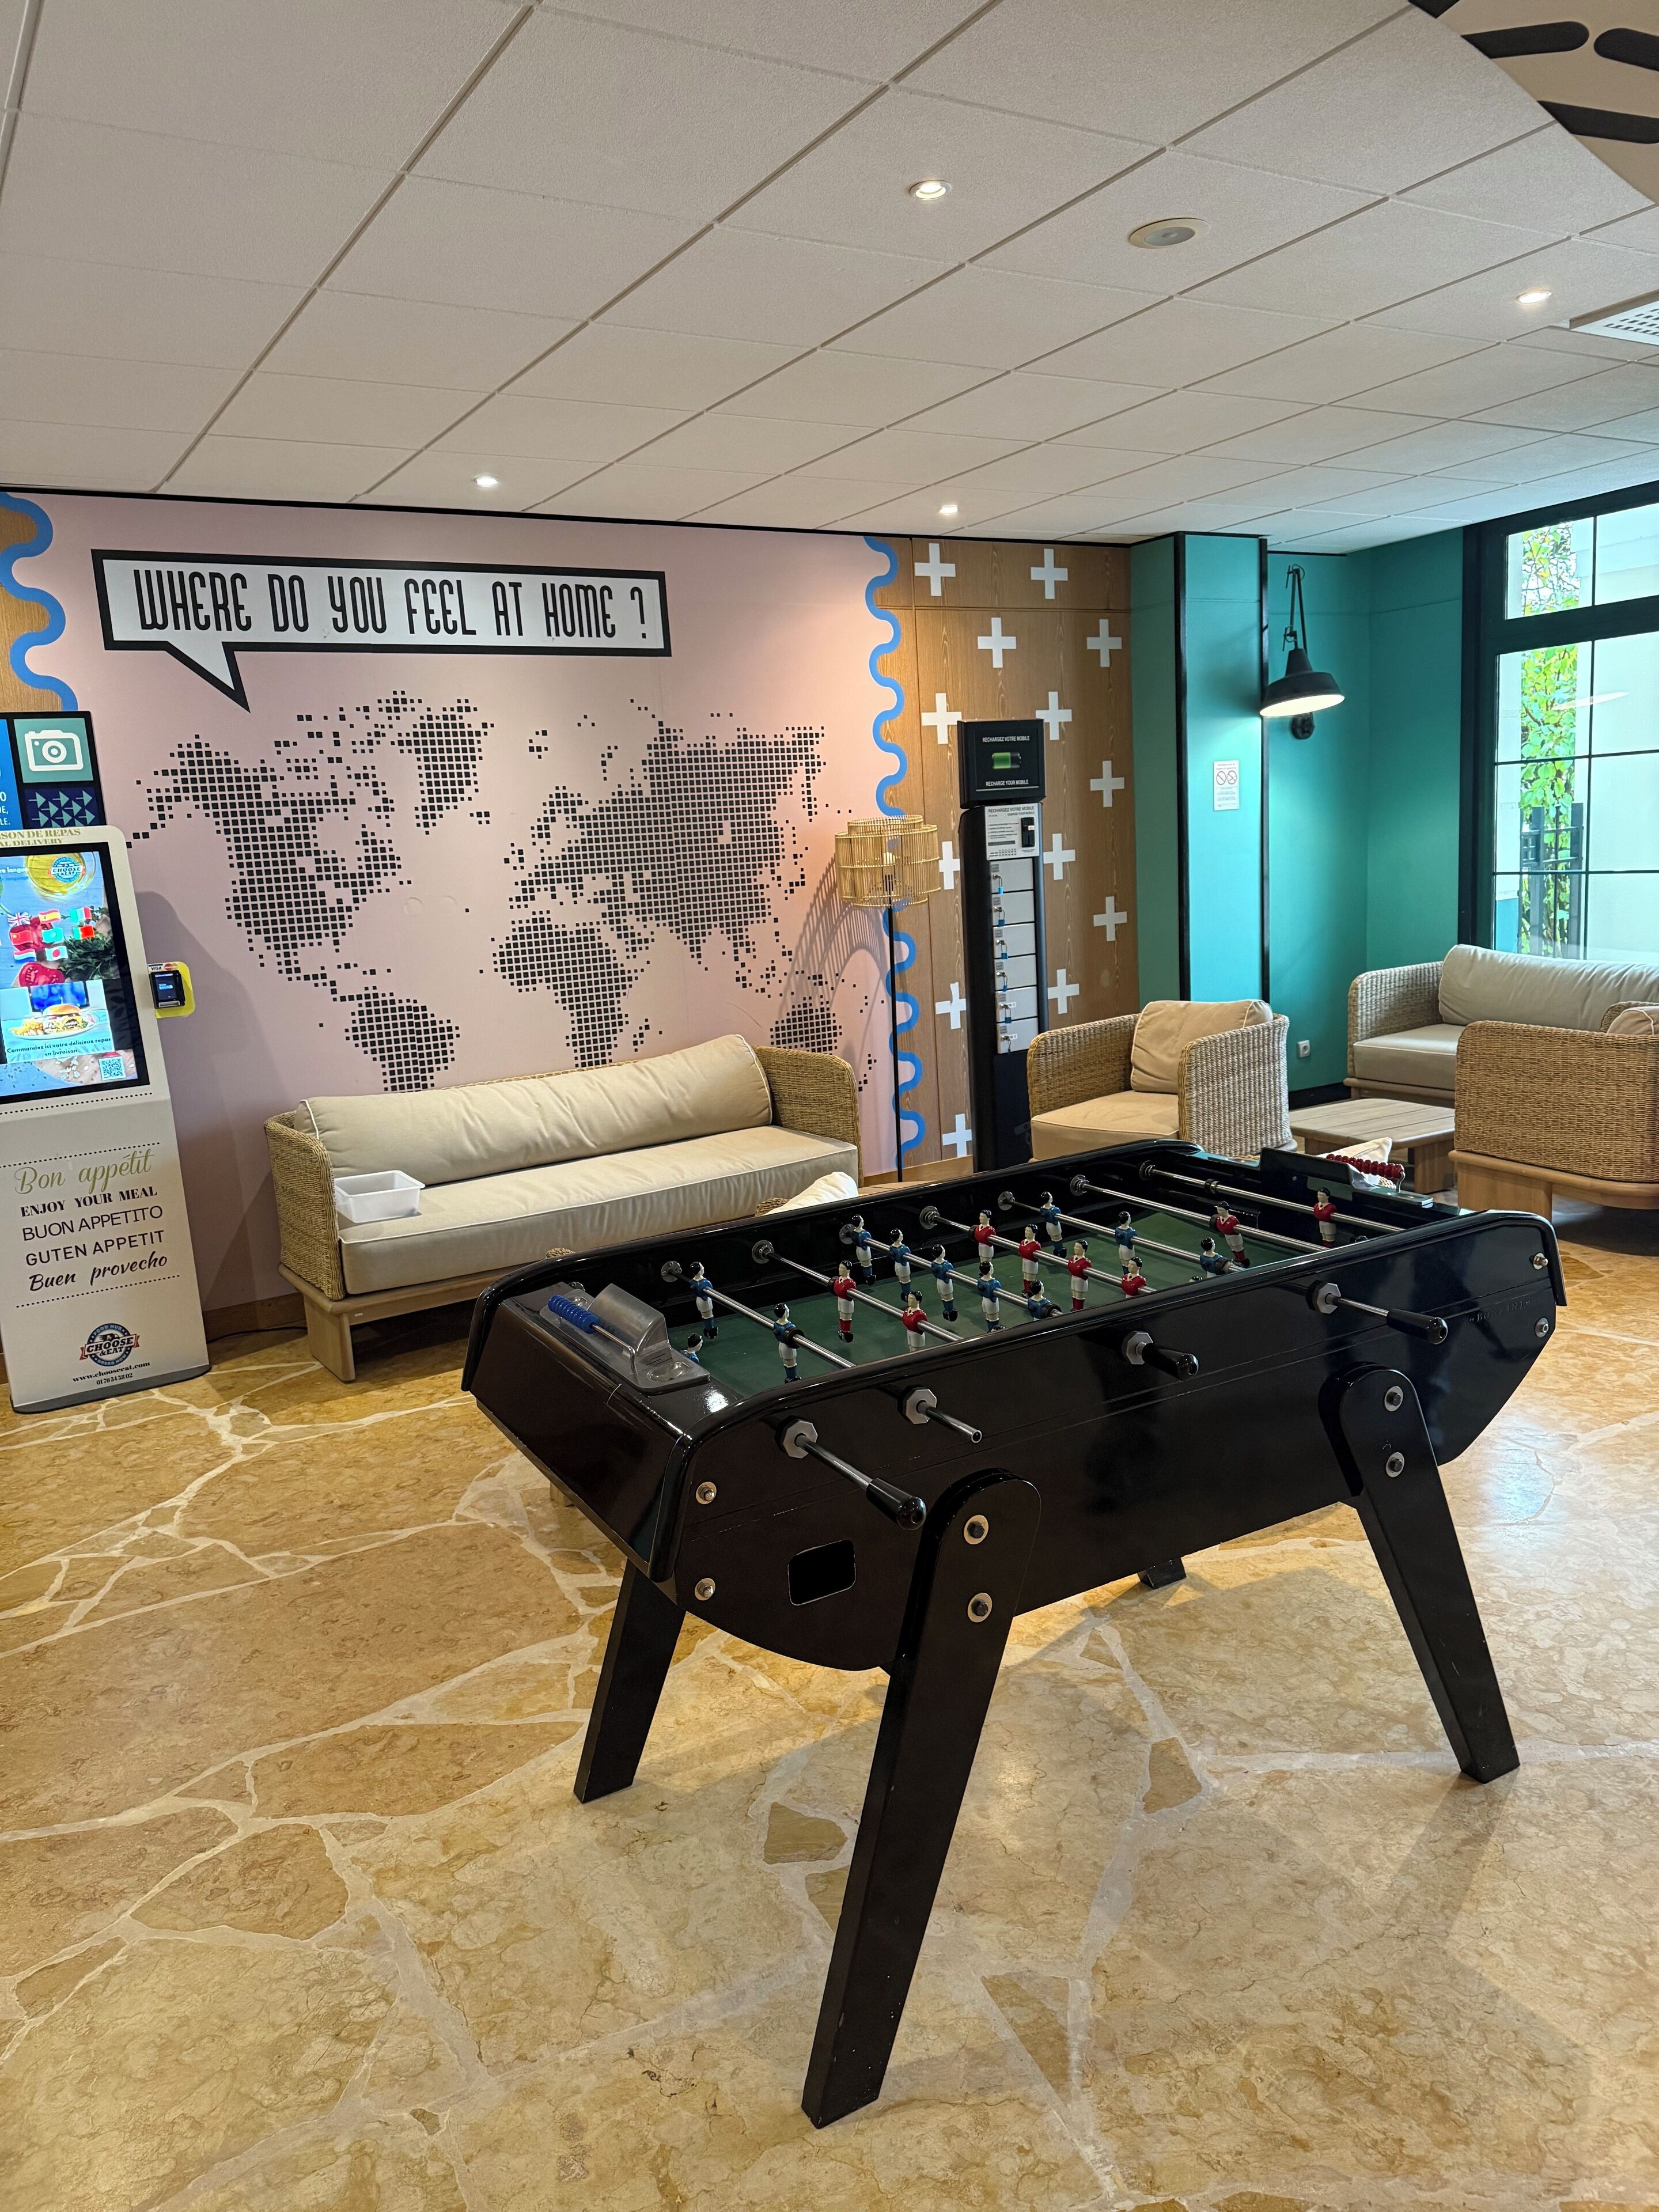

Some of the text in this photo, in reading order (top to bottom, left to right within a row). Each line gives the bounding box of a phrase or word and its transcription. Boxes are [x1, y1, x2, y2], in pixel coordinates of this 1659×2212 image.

[133, 569, 647, 639] WHERE DO YOU FEEL AT HOME ?
[46, 828, 81, 837] REPAS
[7, 1045, 44, 1053] Commandez
[14, 1149, 154, 1195] Bon appétit
[20, 1186, 158, 1217] ENJOY YOUR MEAL
[22, 1206, 163, 1241] BUON APPETITO
[25, 1230, 164, 1266] GUTEN APPETIT
[29, 1251, 167, 1291] Buen provecho
[86, 1336, 134, 1353] CHOOSE
